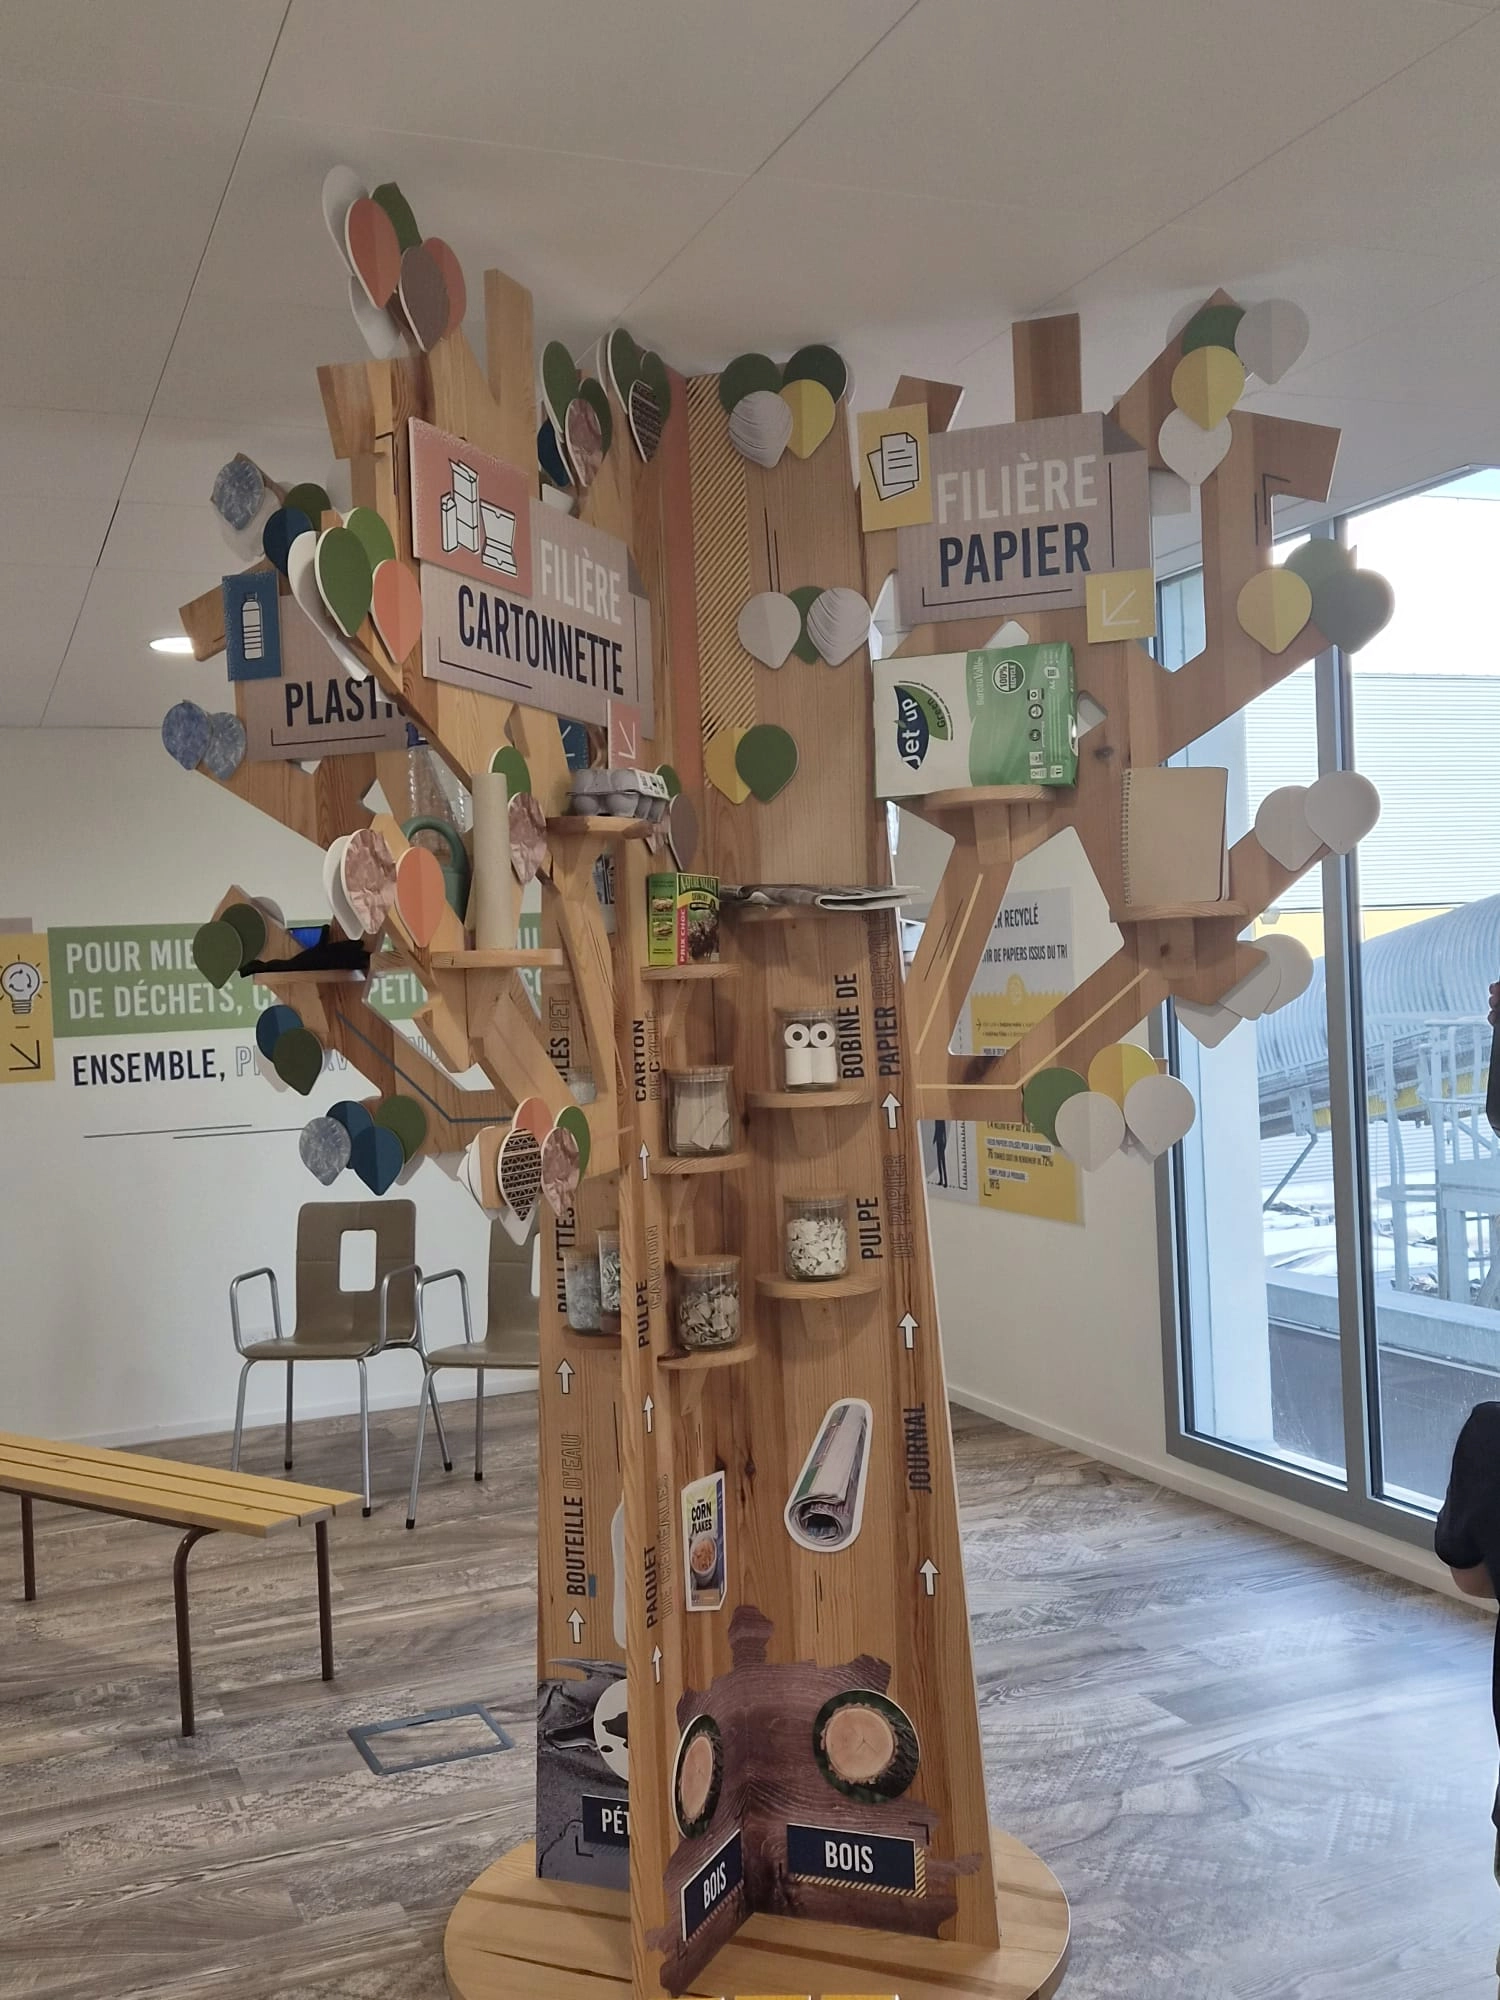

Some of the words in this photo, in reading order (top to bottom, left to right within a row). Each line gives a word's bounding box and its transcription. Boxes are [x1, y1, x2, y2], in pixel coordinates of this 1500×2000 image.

[937, 452, 1098, 525] FILIÈRE
[939, 521, 1091, 588] PAPIER
[540, 538, 622, 626] FILIÈRE
[458, 584, 624, 696] CARTONNETTE
[285, 675, 406, 727] PLAST
[901, 698, 918, 722] up
[927, 697, 946, 728] Green
[902, 729, 921, 767] Jet
[1004, 902, 1039, 928] RECYCLÉ
[66, 941, 142, 974] POUR
[1003, 946, 1028, 961] PAPIERS
[1057, 944, 1068, 959] TRI
[68, 987, 105, 1020] DE
[114, 979, 244, 1018] DÉCHETS,
[834, 973, 859, 999] DE
[549, 997, 570, 1032] PET
[633, 1019, 647, 1102] CARTON
[837, 1005, 865, 1079] BOBINE
[873, 1006, 901, 1077] PAPIER
[72, 1048, 226, 1087] ENSEMBLE,
[883, 1154, 913, 1226] PAPIER
[856, 1197, 883, 1260] PULPE
[889, 1232, 914, 1259] DE
[635, 1280, 650, 1349] PULPE
[561, 1432, 584, 1490] D'EAU
[903, 1402, 932, 1494] JOURNAL
[690, 1519, 712, 1538] FLAKES
[691, 1501, 712, 1522] CORN
[563, 1496, 586, 1596] BOUTEILLE
[644, 1546, 658, 1629] PAQUET
[824, 1840, 874, 1875] BOIS
[703, 1861, 727, 1910] BOIS
